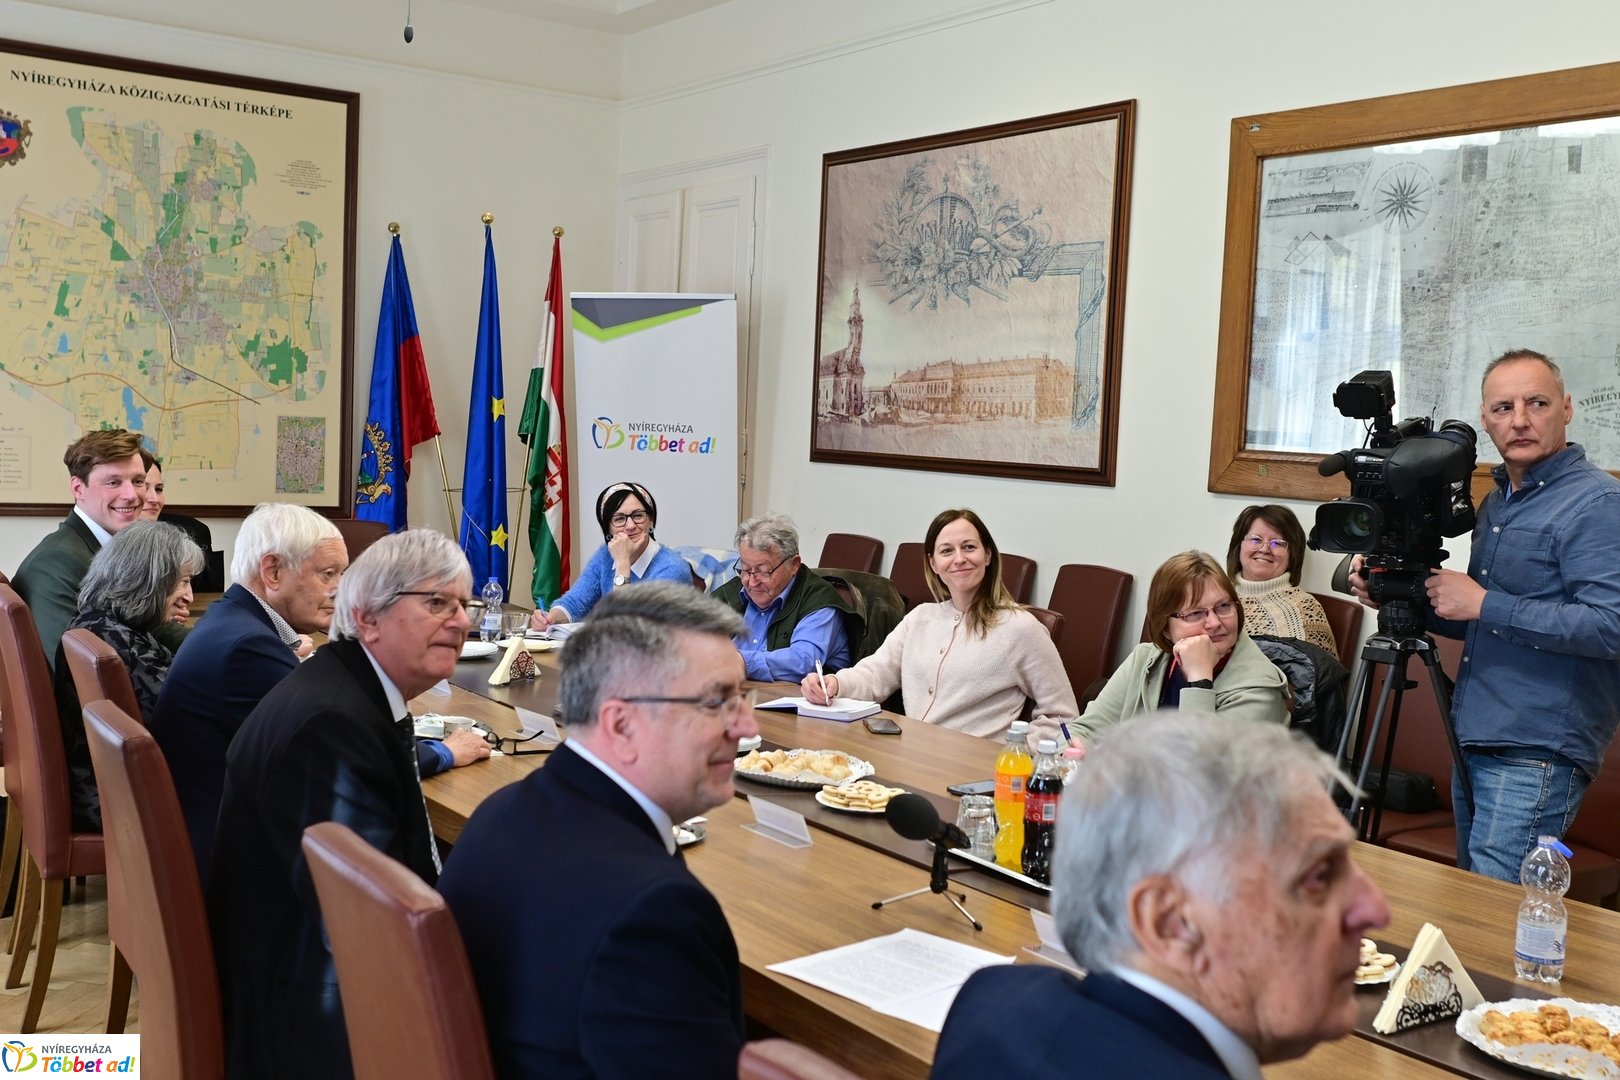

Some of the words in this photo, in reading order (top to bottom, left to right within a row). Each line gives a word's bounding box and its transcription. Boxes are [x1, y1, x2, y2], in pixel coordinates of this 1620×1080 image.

[10, 70, 116, 95] NYÍREGYHÁZA
[119, 86, 230, 111] KÖZIGAZGATÁSI
[234, 101, 293, 119] TÉRKÉPE
[628, 421, 694, 434] NYÍREGYHÁZA
[628, 434, 685, 453] Többet
[688, 437, 717, 454] ad!
